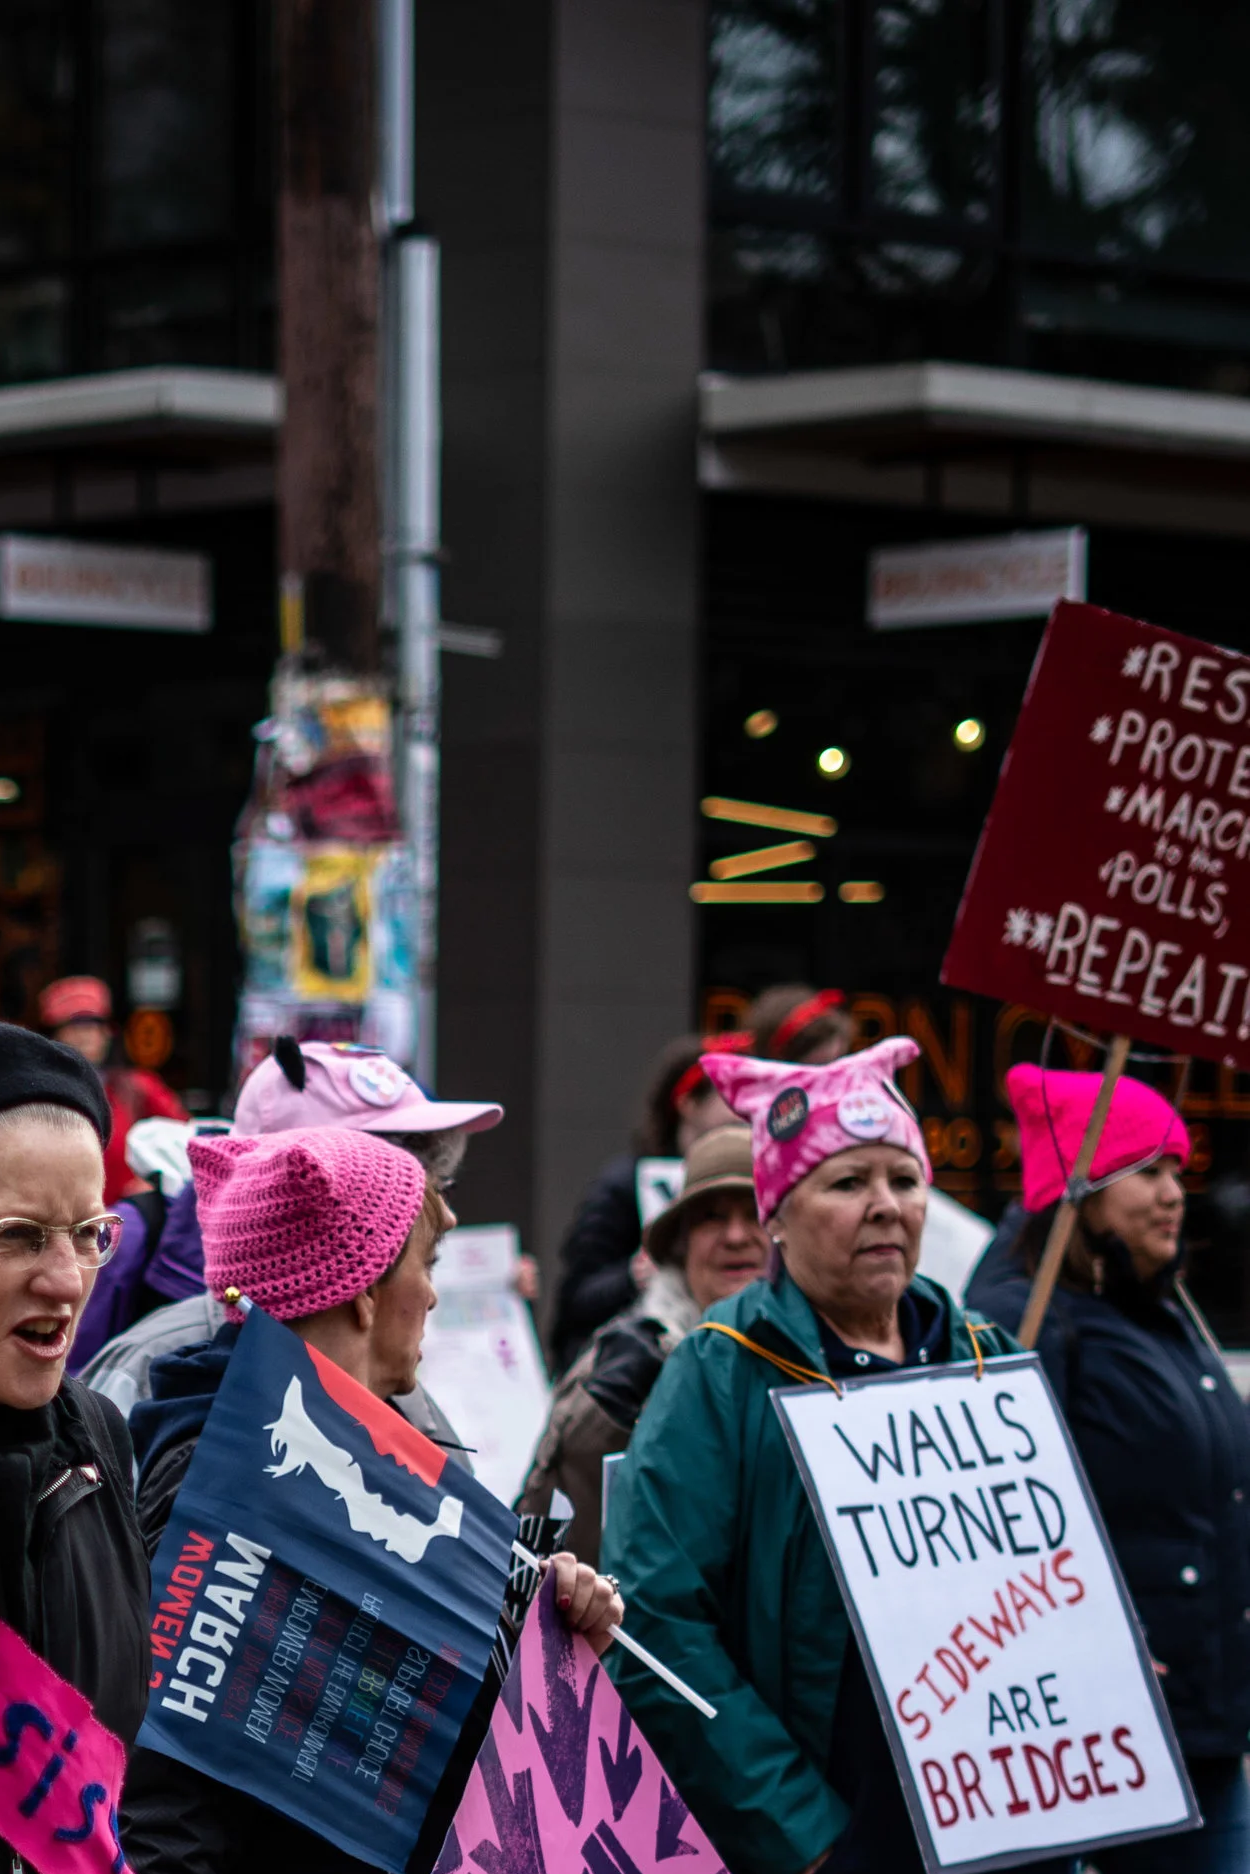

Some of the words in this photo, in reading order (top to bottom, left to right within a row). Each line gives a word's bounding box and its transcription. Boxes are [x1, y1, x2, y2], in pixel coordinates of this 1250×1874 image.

[1154, 834, 1182, 866] to
[1189, 845, 1225, 877] the
[833, 1391, 1038, 1484] WALLS
[836, 1477, 1066, 1577] TURNED
[895, 1548, 1087, 1741] SIDEWAYS
[987, 1673, 1067, 1736] ARE
[919, 1726, 1147, 1828] BRIDGES
